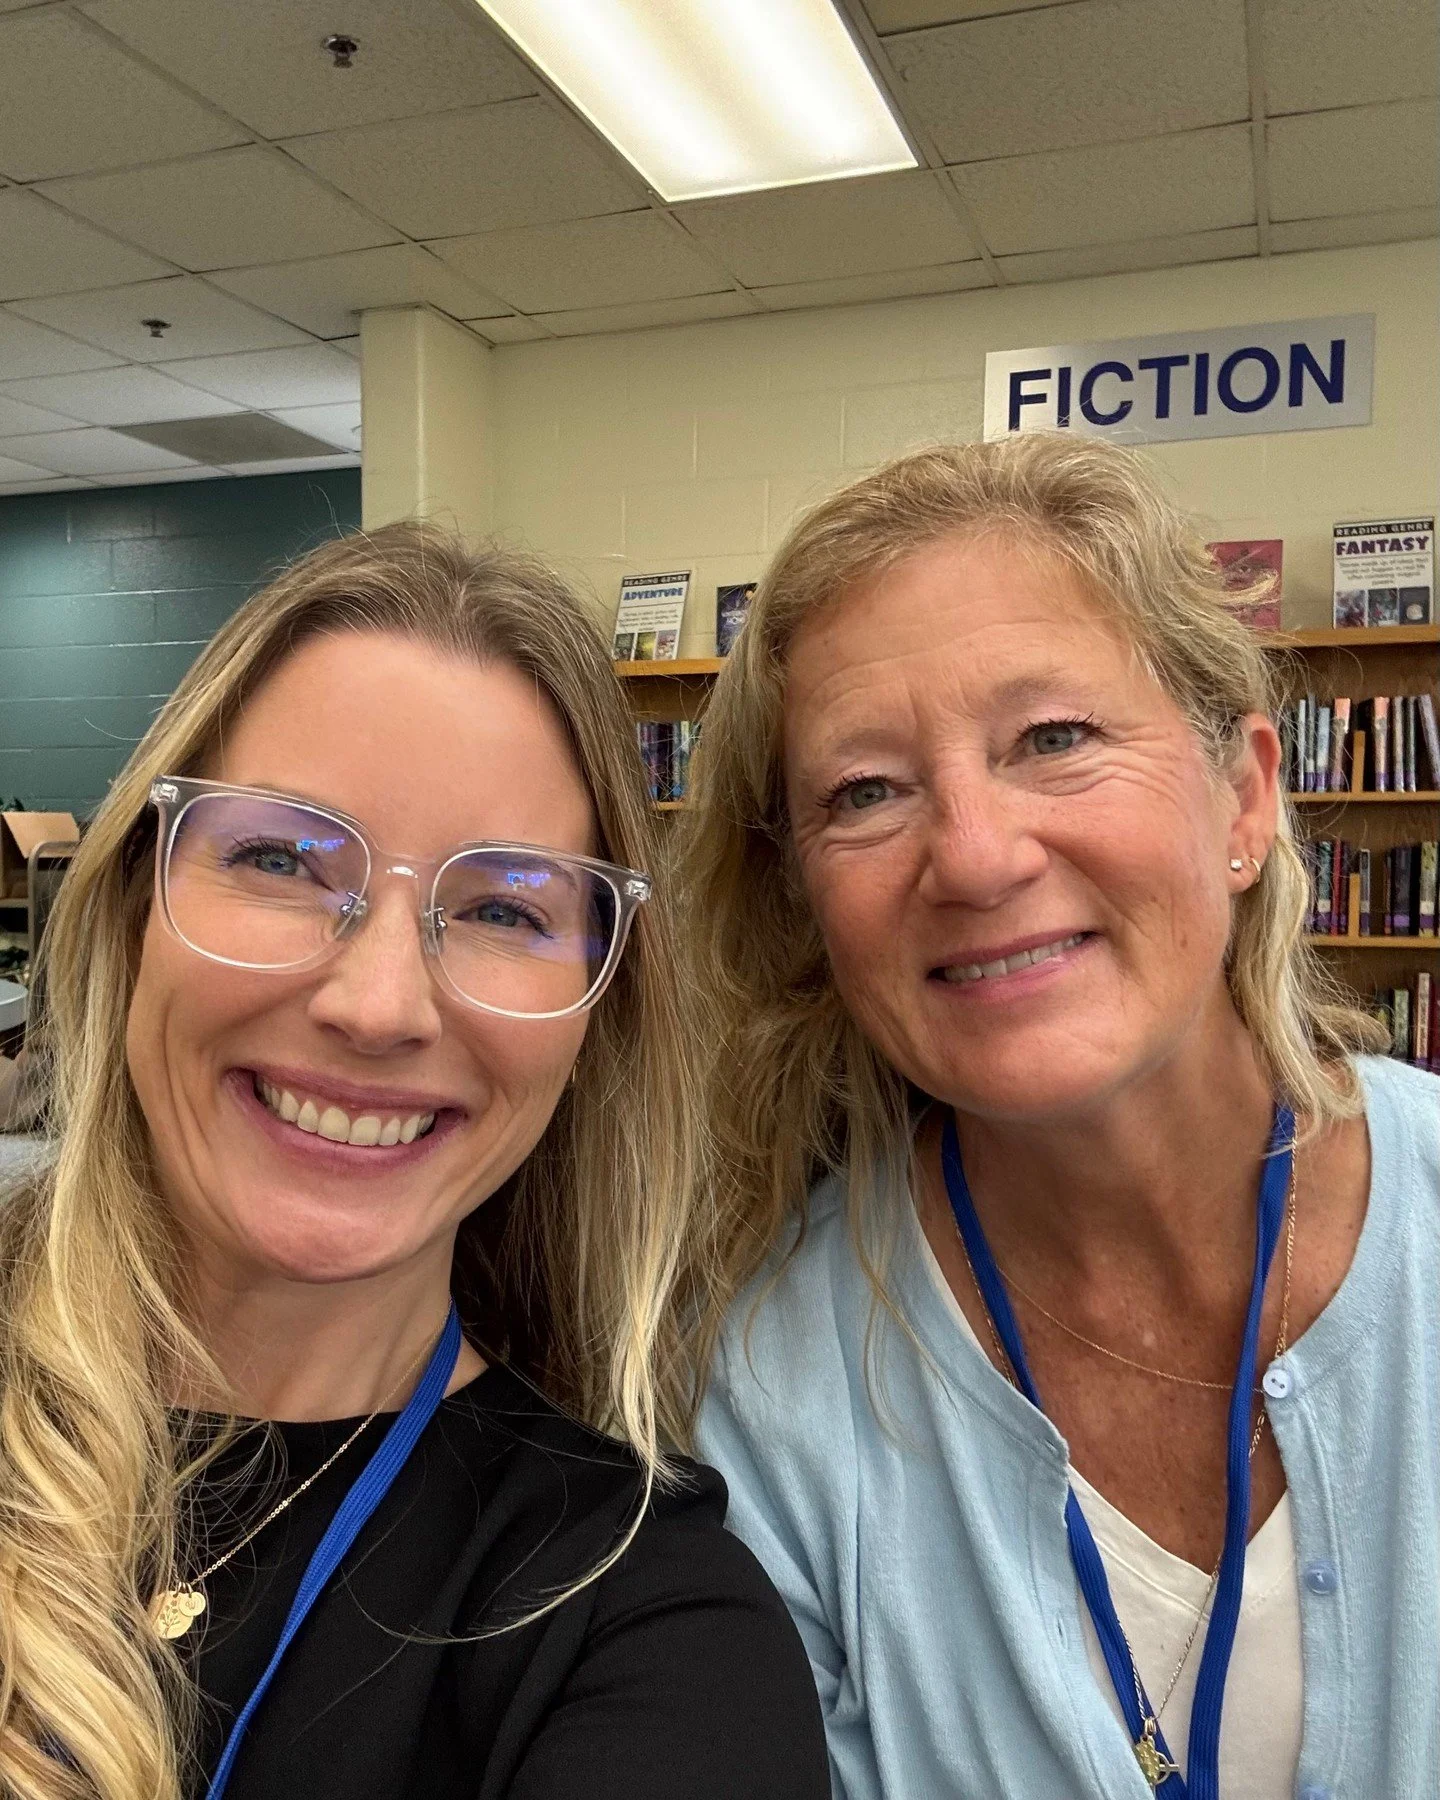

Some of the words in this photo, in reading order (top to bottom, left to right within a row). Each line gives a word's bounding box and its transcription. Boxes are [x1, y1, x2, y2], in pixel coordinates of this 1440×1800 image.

[1008, 338, 1346, 432] FICTION
[1336, 526, 1387, 536] READING
[1391, 522, 1429, 531] GENRE
[1336, 536, 1429, 555] FANTASY
[624, 578, 658, 586] READING
[624, 588, 683, 600] ADVENTURE
